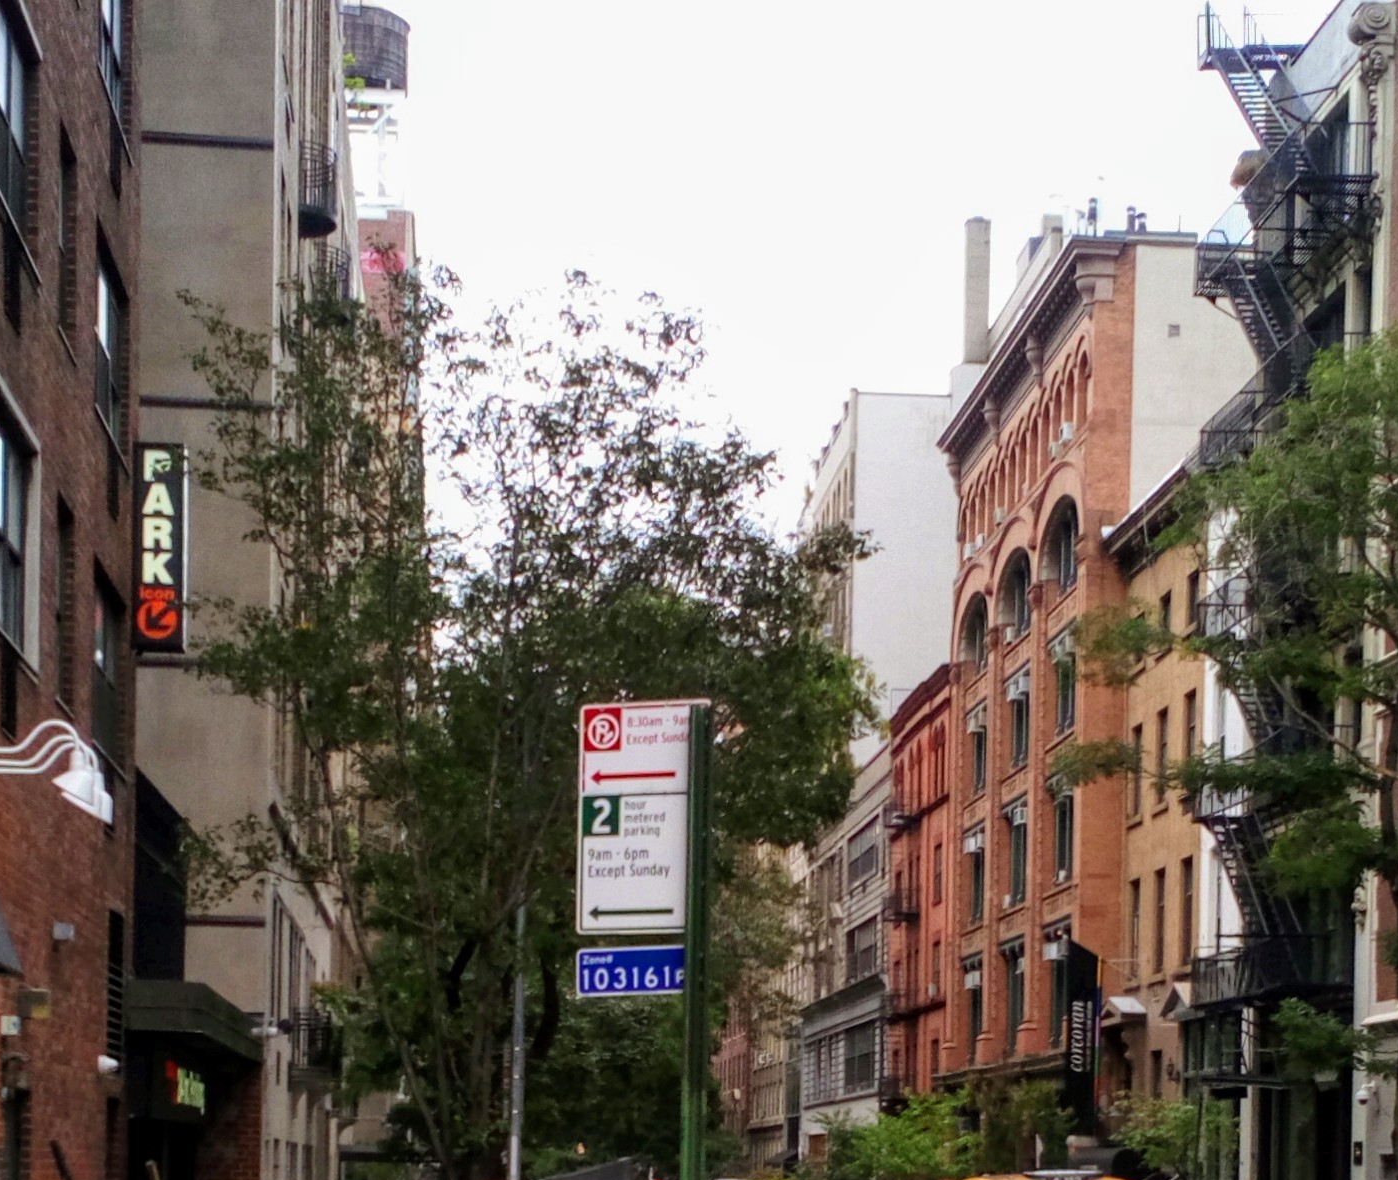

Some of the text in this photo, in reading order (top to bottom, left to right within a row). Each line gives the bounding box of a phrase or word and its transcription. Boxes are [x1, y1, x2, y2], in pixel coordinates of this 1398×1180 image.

[142, 449, 175, 585] PARK
[626, 731, 690, 746] Except Sunda
[624, 800, 647, 811] hour
[591, 798, 612, 835] 2
[624, 812, 666, 824] metered
[624, 825, 661, 838] parking
[588, 848, 612, 861] 9am
[624, 847, 649, 862] 6pm
[588, 863, 670, 879] Except Sunday
[1070, 1001, 1084, 1073] corcoran
